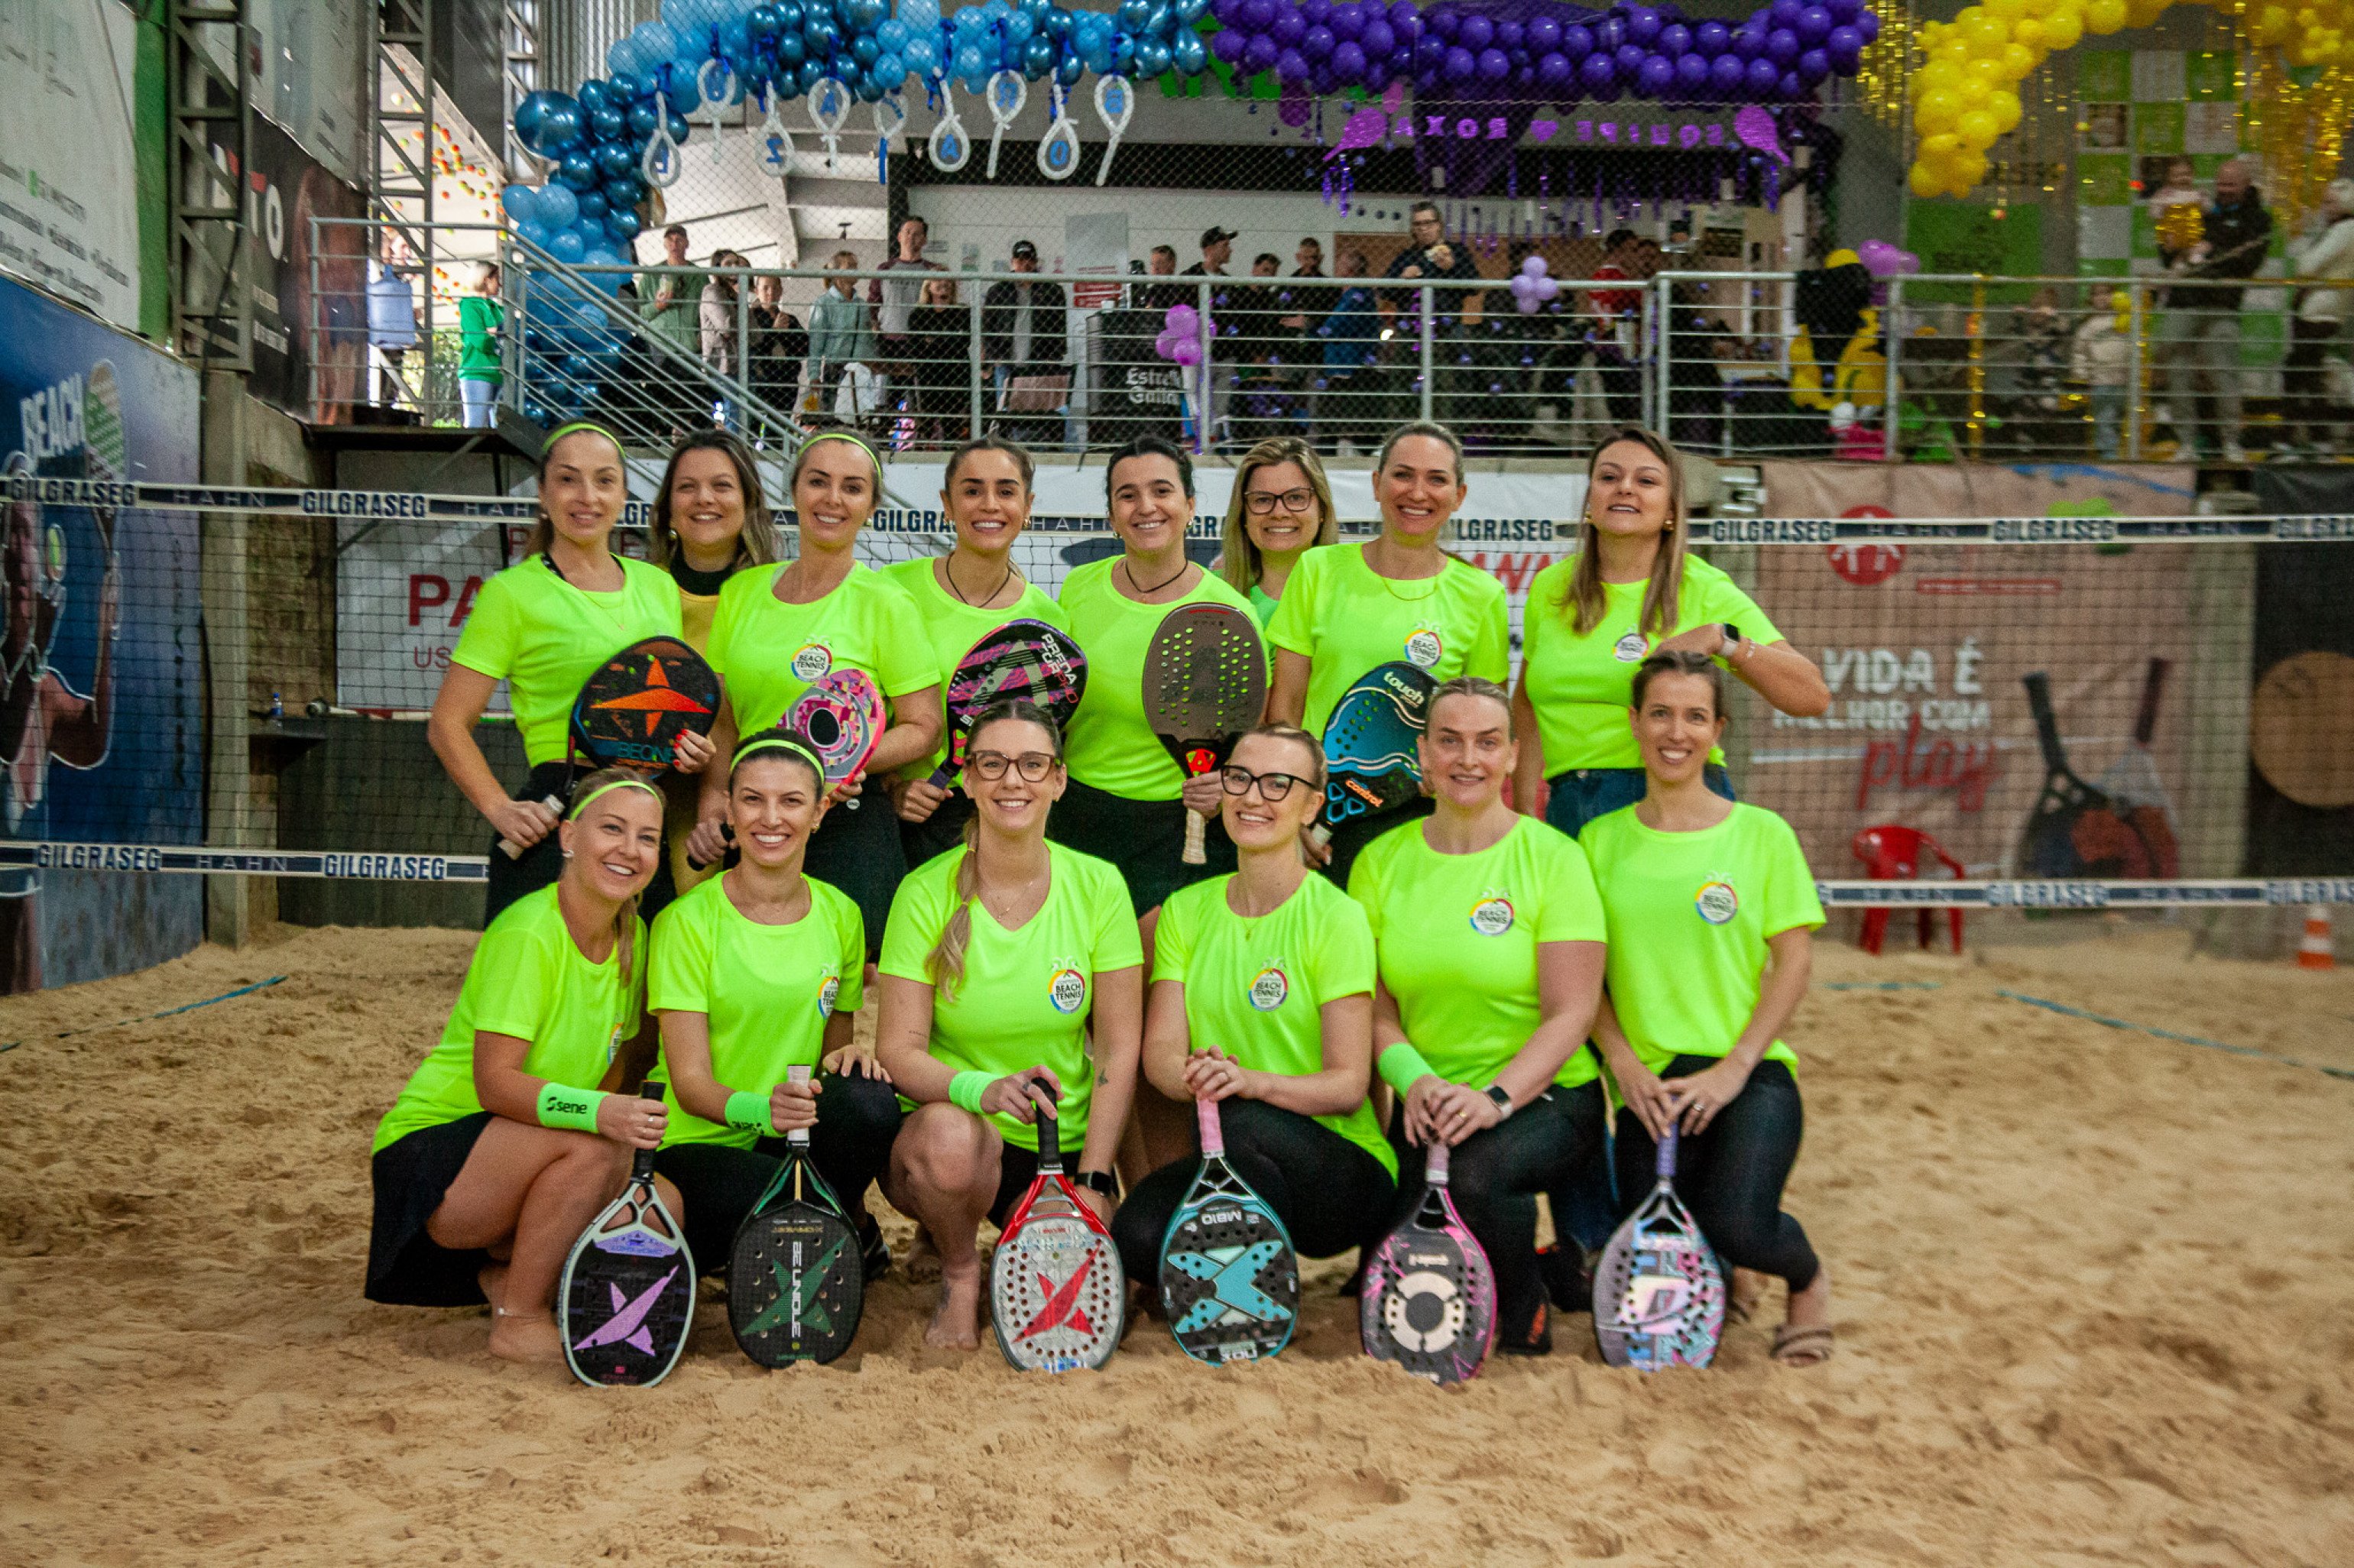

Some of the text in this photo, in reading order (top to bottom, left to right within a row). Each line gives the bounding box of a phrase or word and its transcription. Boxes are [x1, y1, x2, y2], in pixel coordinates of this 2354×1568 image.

[10, 478, 136, 507] GILGRASEG
[303, 491, 426, 518] GILGRASEG
[465, 503, 529, 517] HAH
[874, 510, 956, 533] GILGRA
[1712, 520, 1833, 542] GILGRASEG
[1992, 520, 2116, 542] GILGRASEG
[796, 661, 825, 670] TENNIS
[798, 654, 826, 663] BEACH
[1823, 636, 1986, 694] VIDA É
[1383, 670, 1425, 706] touch
[1855, 712, 2001, 813] play
[1345, 778, 1384, 808] control
[36, 844, 445, 880] GILGRASEG HAHN GILGRASEG
[1055, 983, 1081, 994] BEACH
[1055, 991, 1081, 1001] TENNIS
[1256, 982, 1282, 991] BEACH
[556, 1101, 588, 1115] sene
